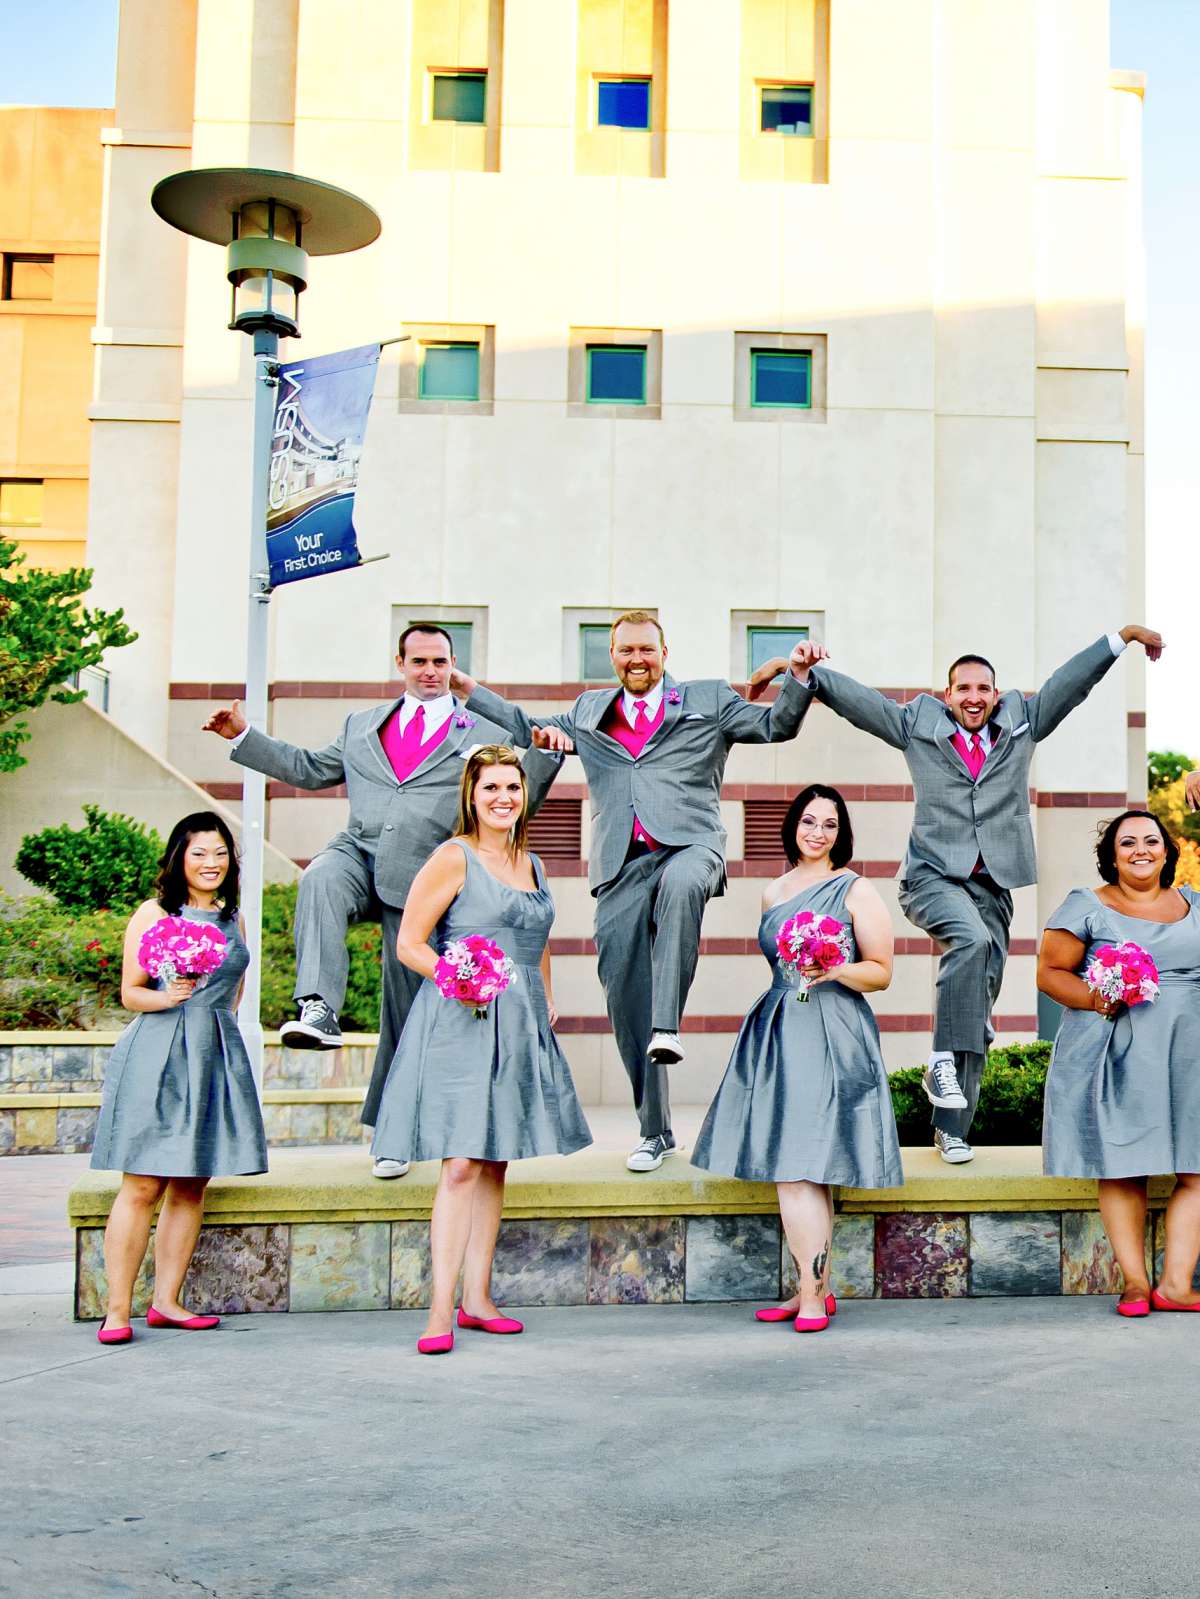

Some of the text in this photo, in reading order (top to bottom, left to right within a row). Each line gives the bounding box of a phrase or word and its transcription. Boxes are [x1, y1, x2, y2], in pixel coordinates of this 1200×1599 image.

[294, 532, 324, 552] Your
[284, 549, 342, 573] First Choice
